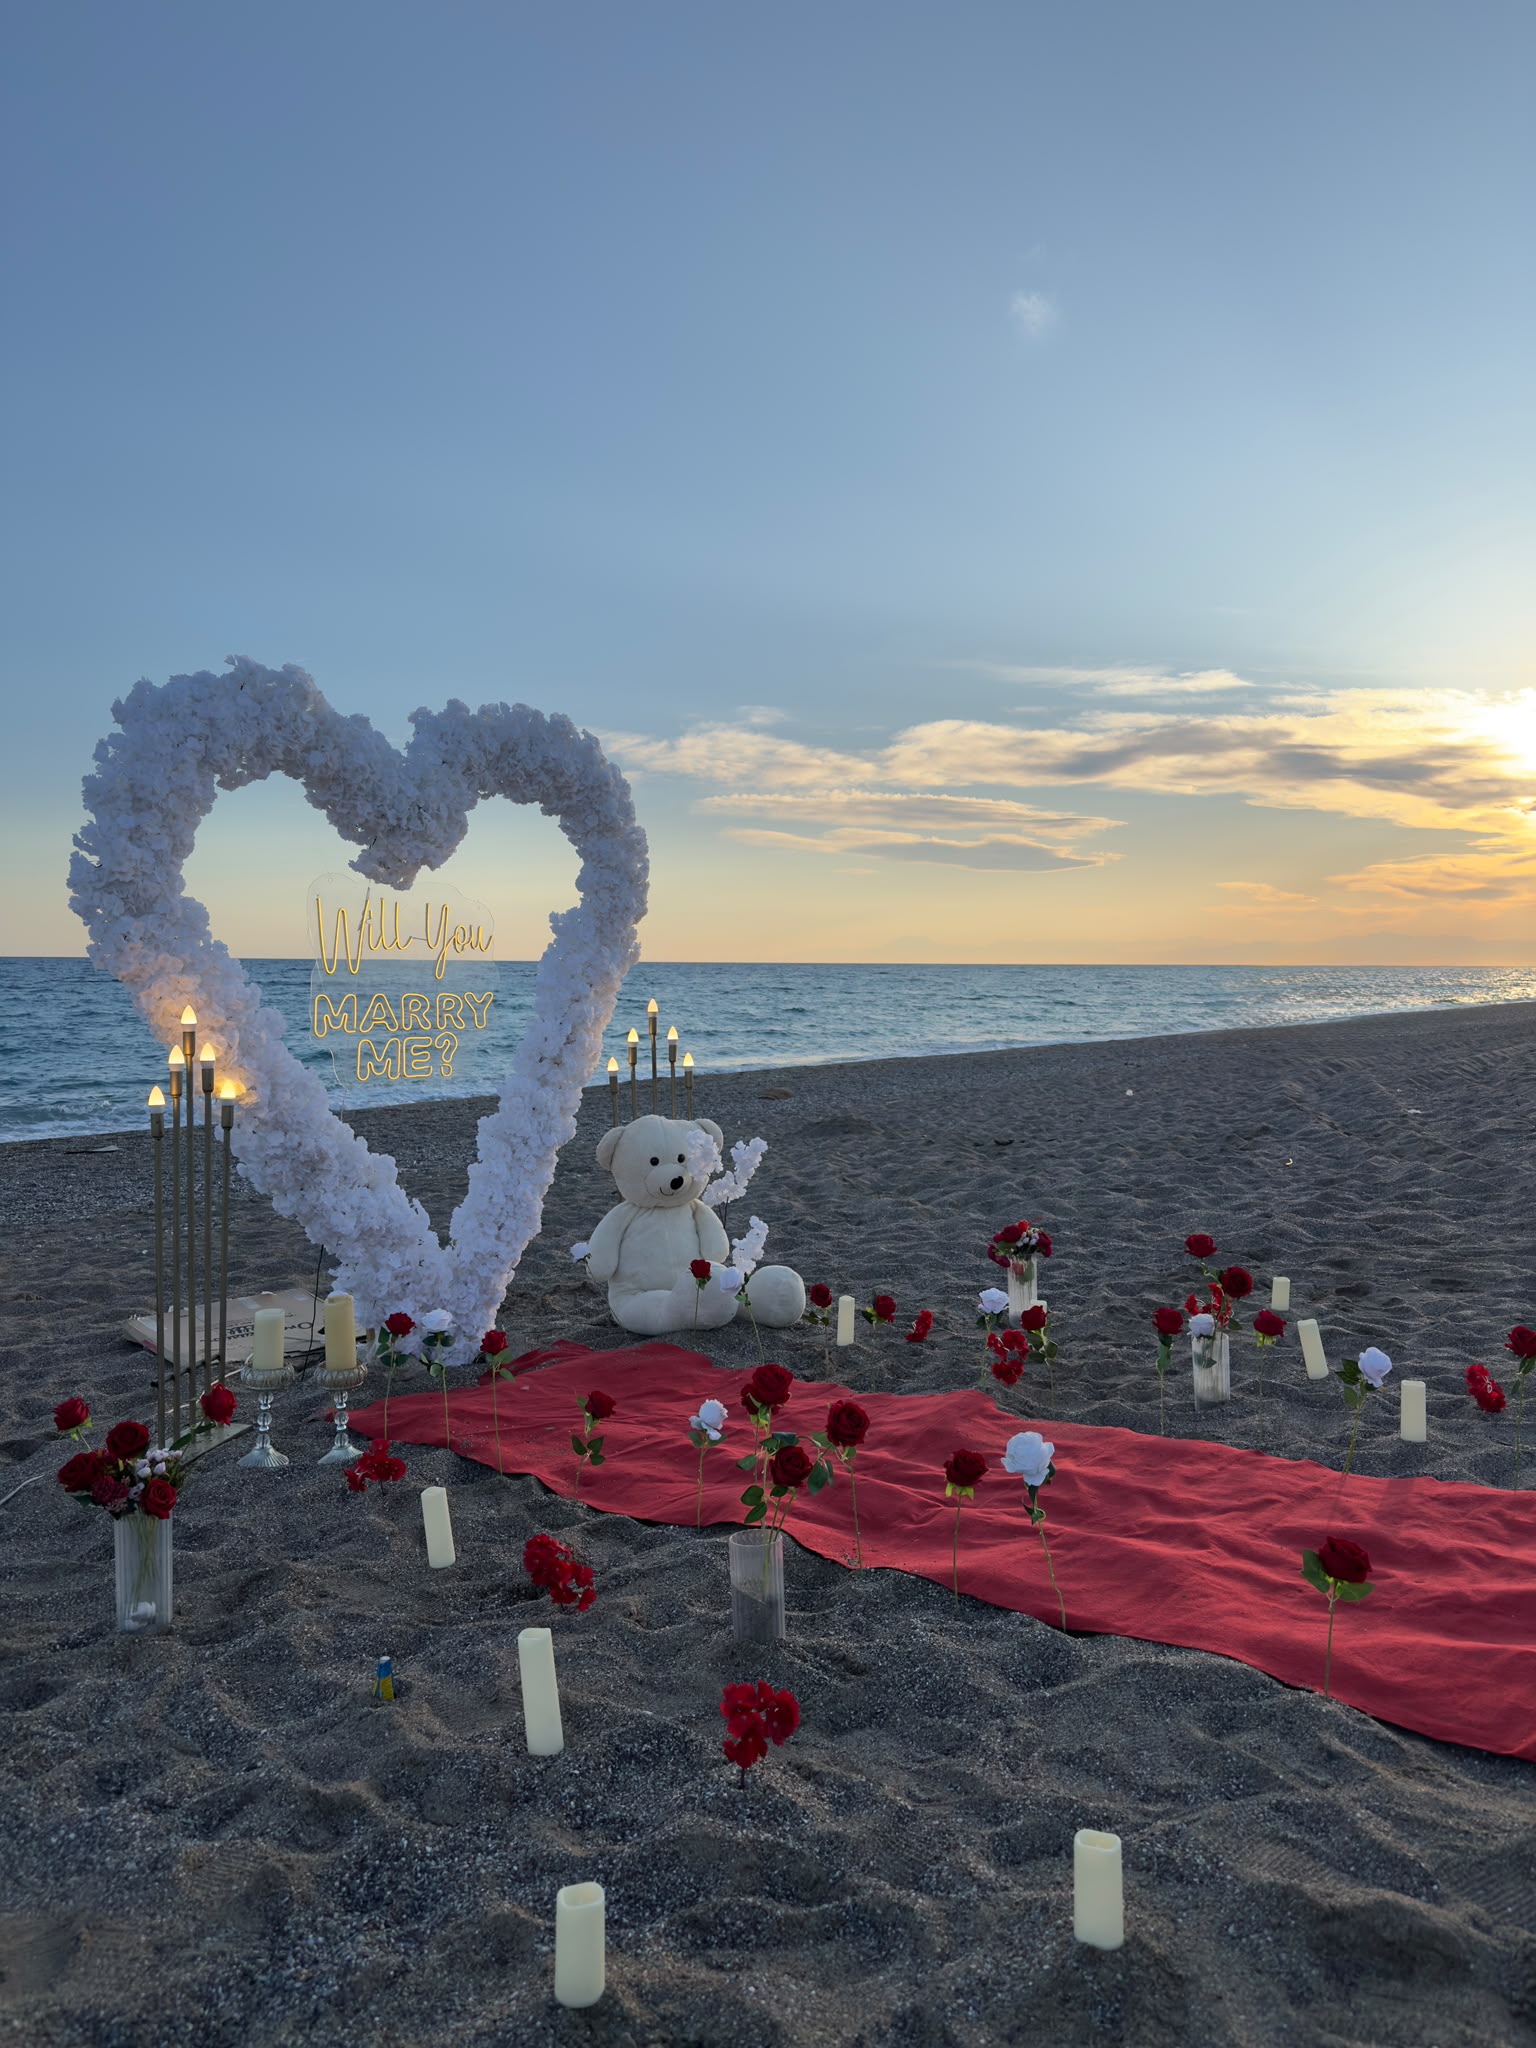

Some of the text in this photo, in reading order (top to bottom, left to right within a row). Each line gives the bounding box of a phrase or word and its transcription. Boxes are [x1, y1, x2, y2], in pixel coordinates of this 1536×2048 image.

[316, 897, 494, 979] Will You
[314, 992, 494, 1037] MARRY
[357, 1032, 458, 1081] ME?
